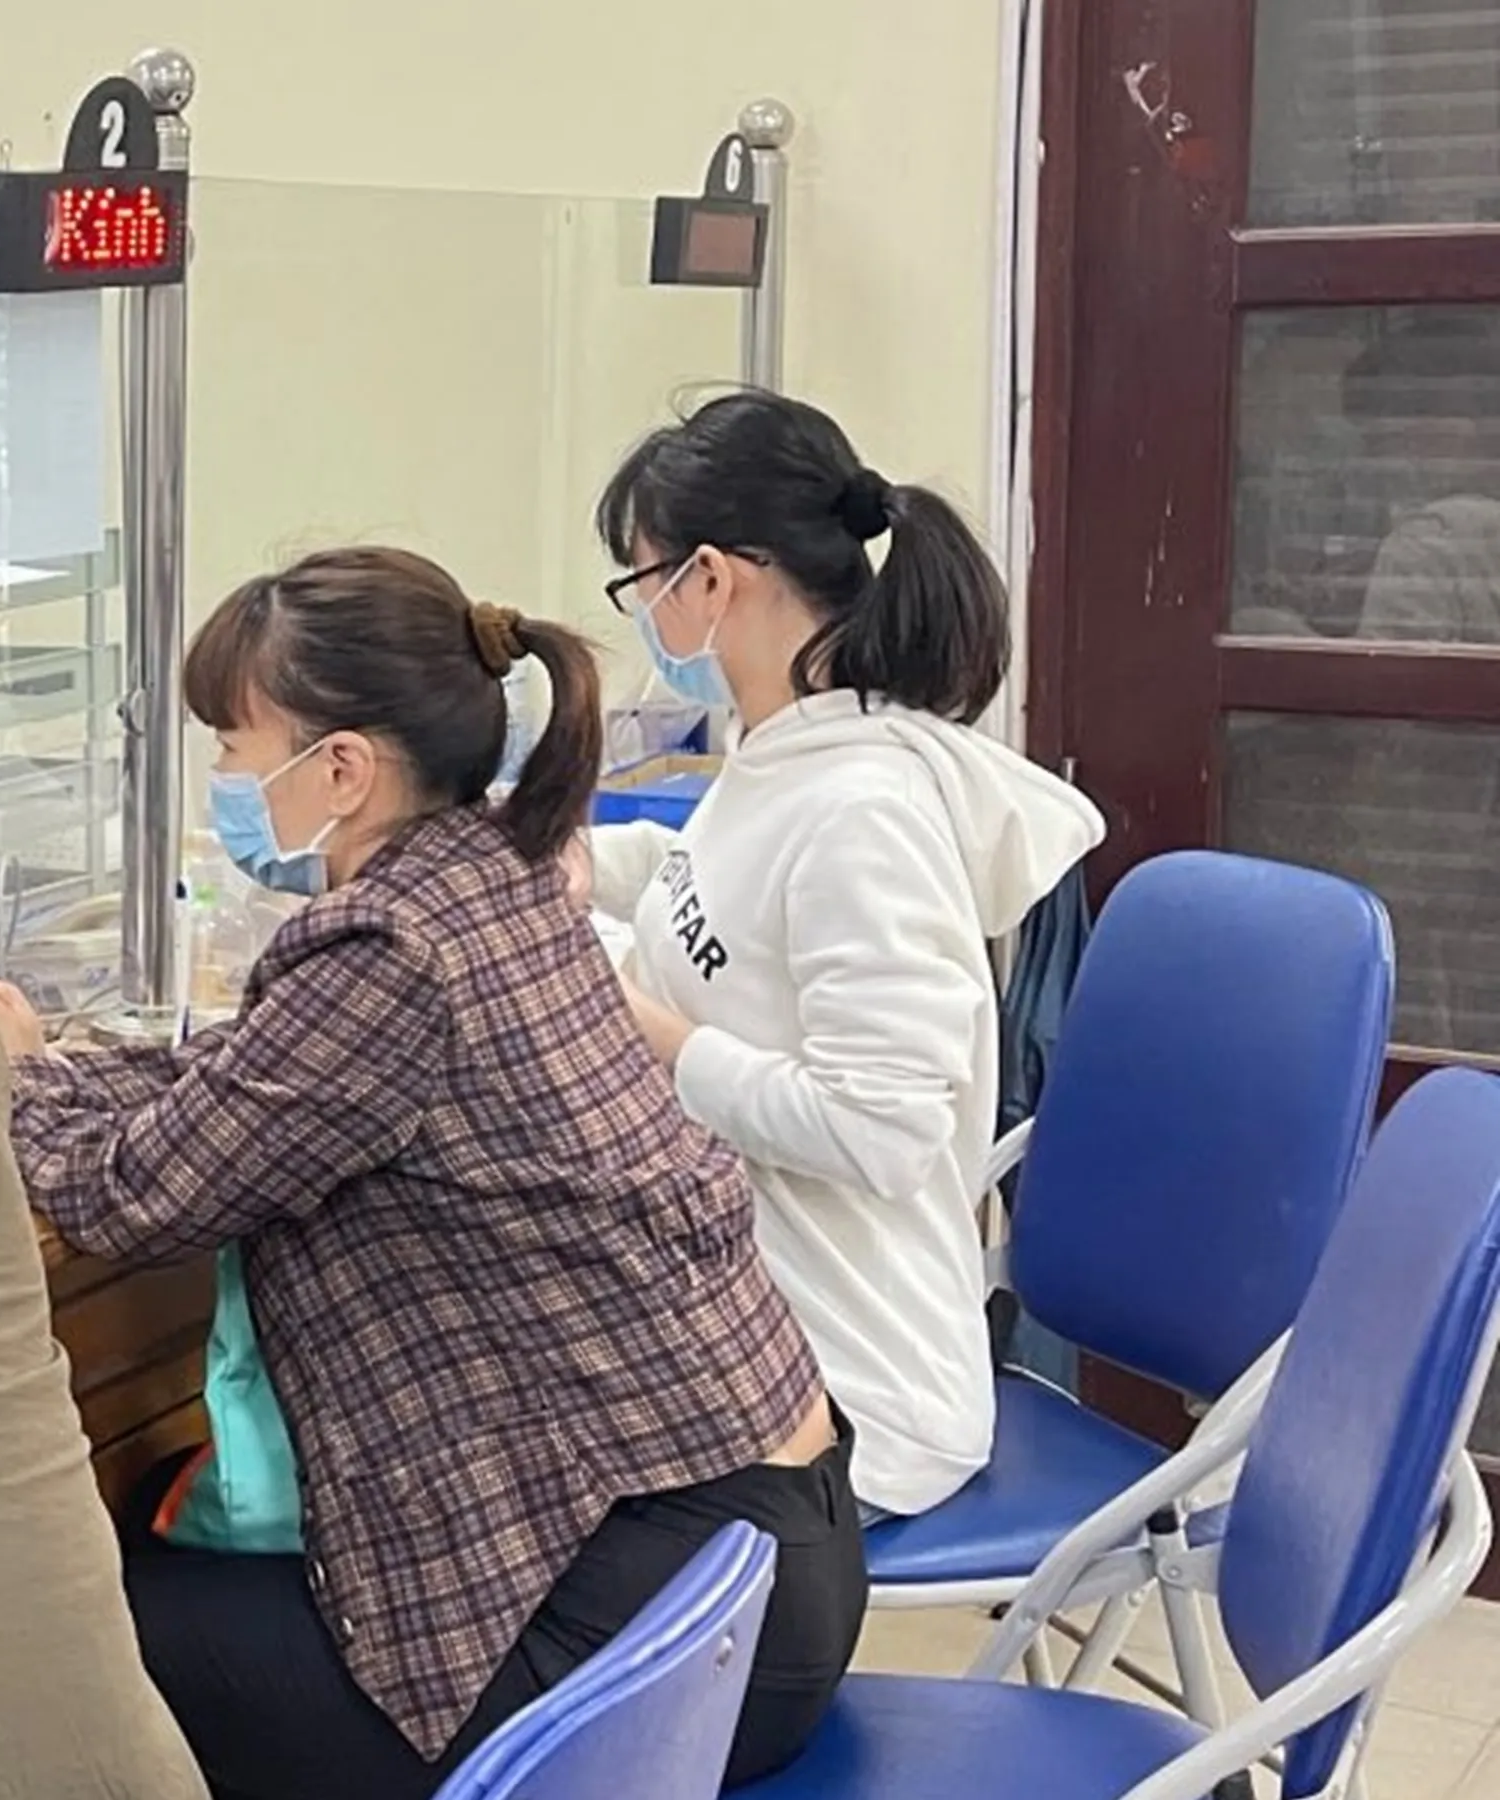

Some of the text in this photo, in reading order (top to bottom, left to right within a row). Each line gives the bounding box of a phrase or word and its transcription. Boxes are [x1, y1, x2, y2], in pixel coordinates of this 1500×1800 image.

[100, 100, 127, 168] 2
[725, 138, 742, 193] 6
[672, 892, 728, 982] FAR
